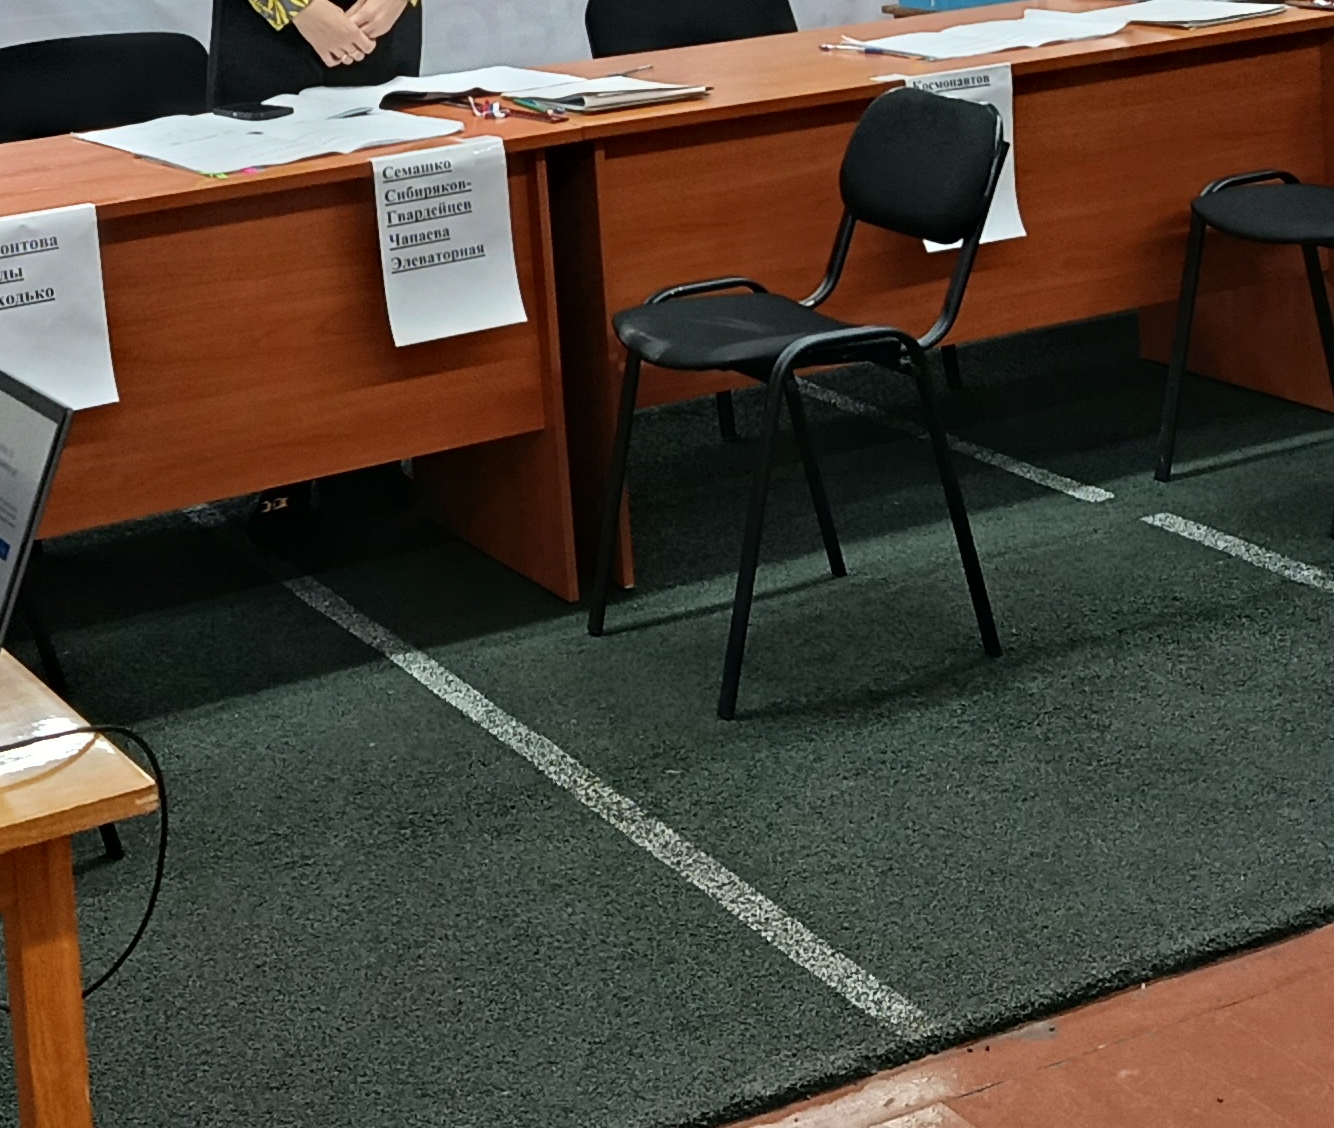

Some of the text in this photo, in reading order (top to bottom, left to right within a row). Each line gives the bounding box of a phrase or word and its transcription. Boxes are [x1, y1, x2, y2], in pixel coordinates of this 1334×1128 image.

[382, 159, 452, 181] Семашко
[384, 180, 472, 204] Сибиряков-
[386, 200, 472, 225] Гвардейцев
[389, 227, 450, 248] Чапаева
[391, 244, 485, 271] Элеваторная
